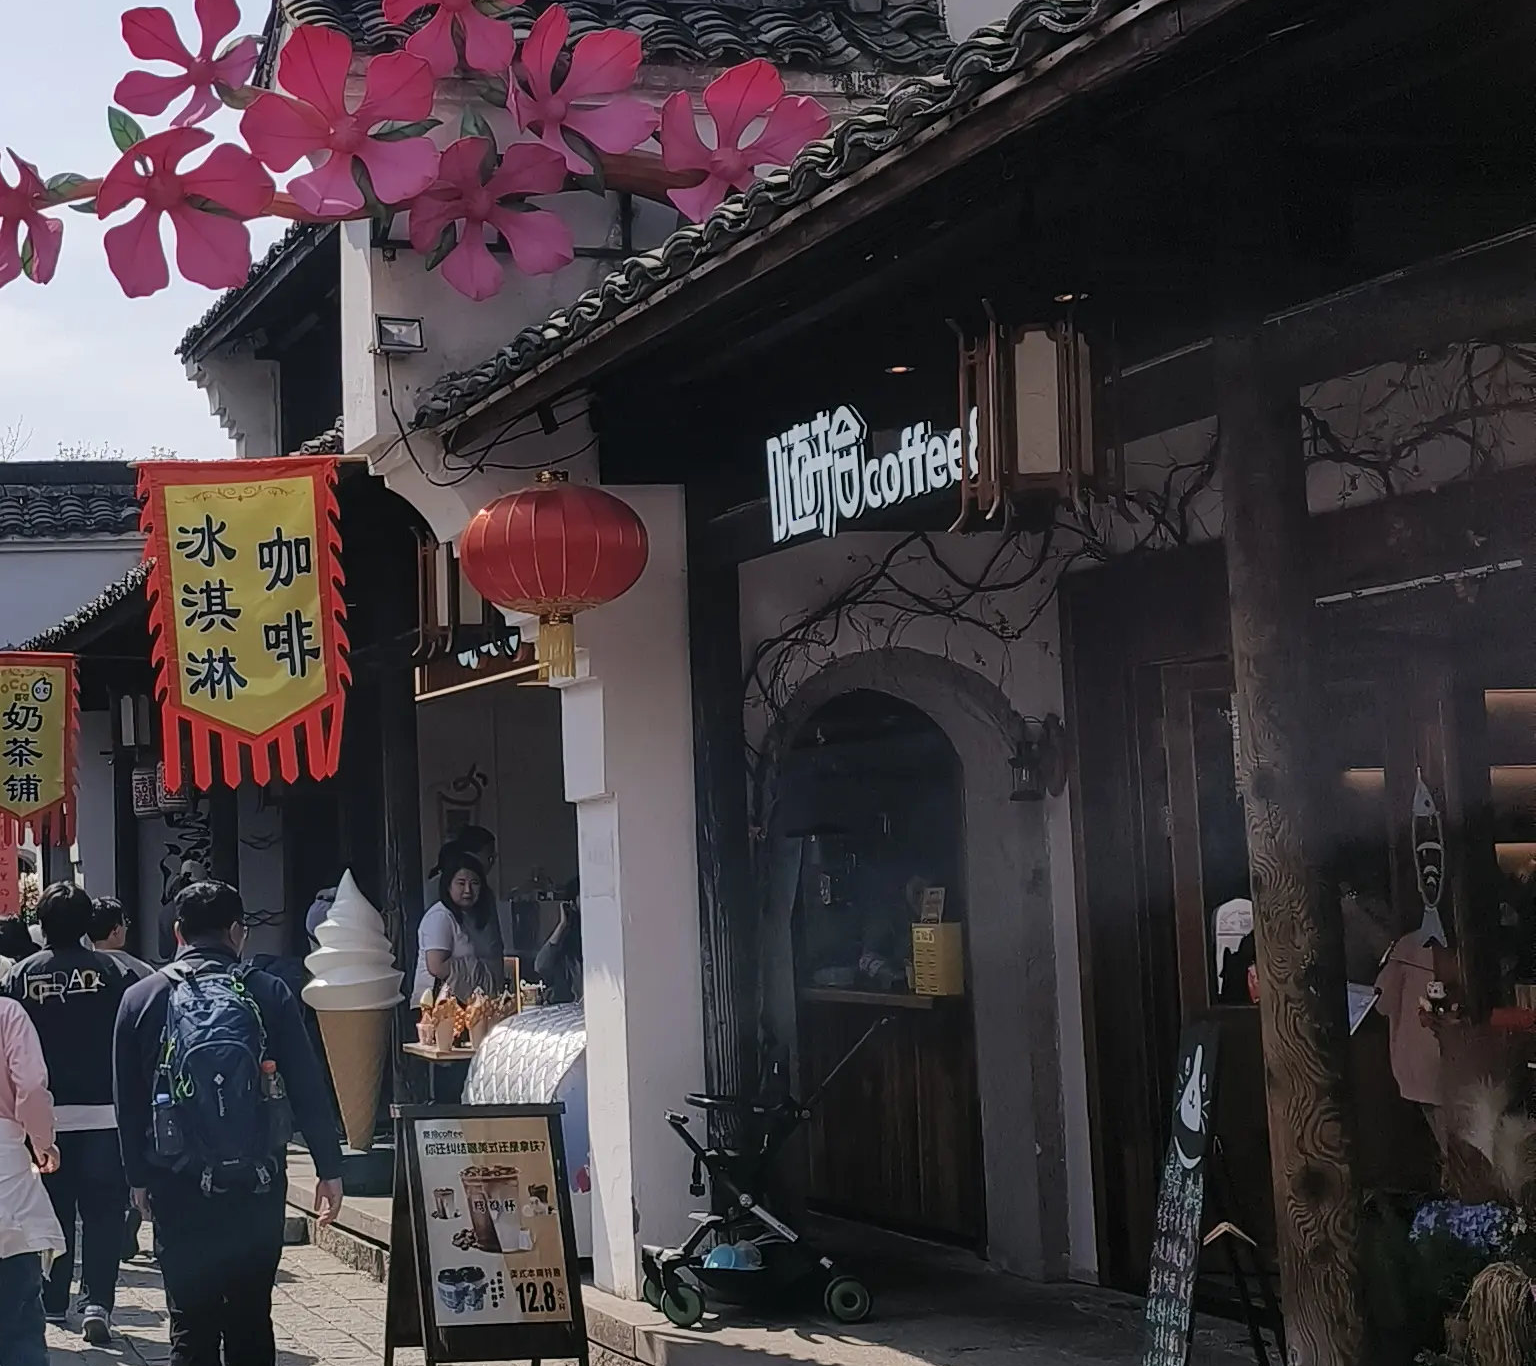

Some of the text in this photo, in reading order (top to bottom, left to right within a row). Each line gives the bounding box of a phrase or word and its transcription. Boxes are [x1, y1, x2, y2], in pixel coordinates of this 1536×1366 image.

[175, 513, 248, 701] 冰淇淋
[258, 526, 321, 679] 咖啡
[2, 702, 44, 803] 奶茶铺
[515, 1281, 556, 1313] 12.8
